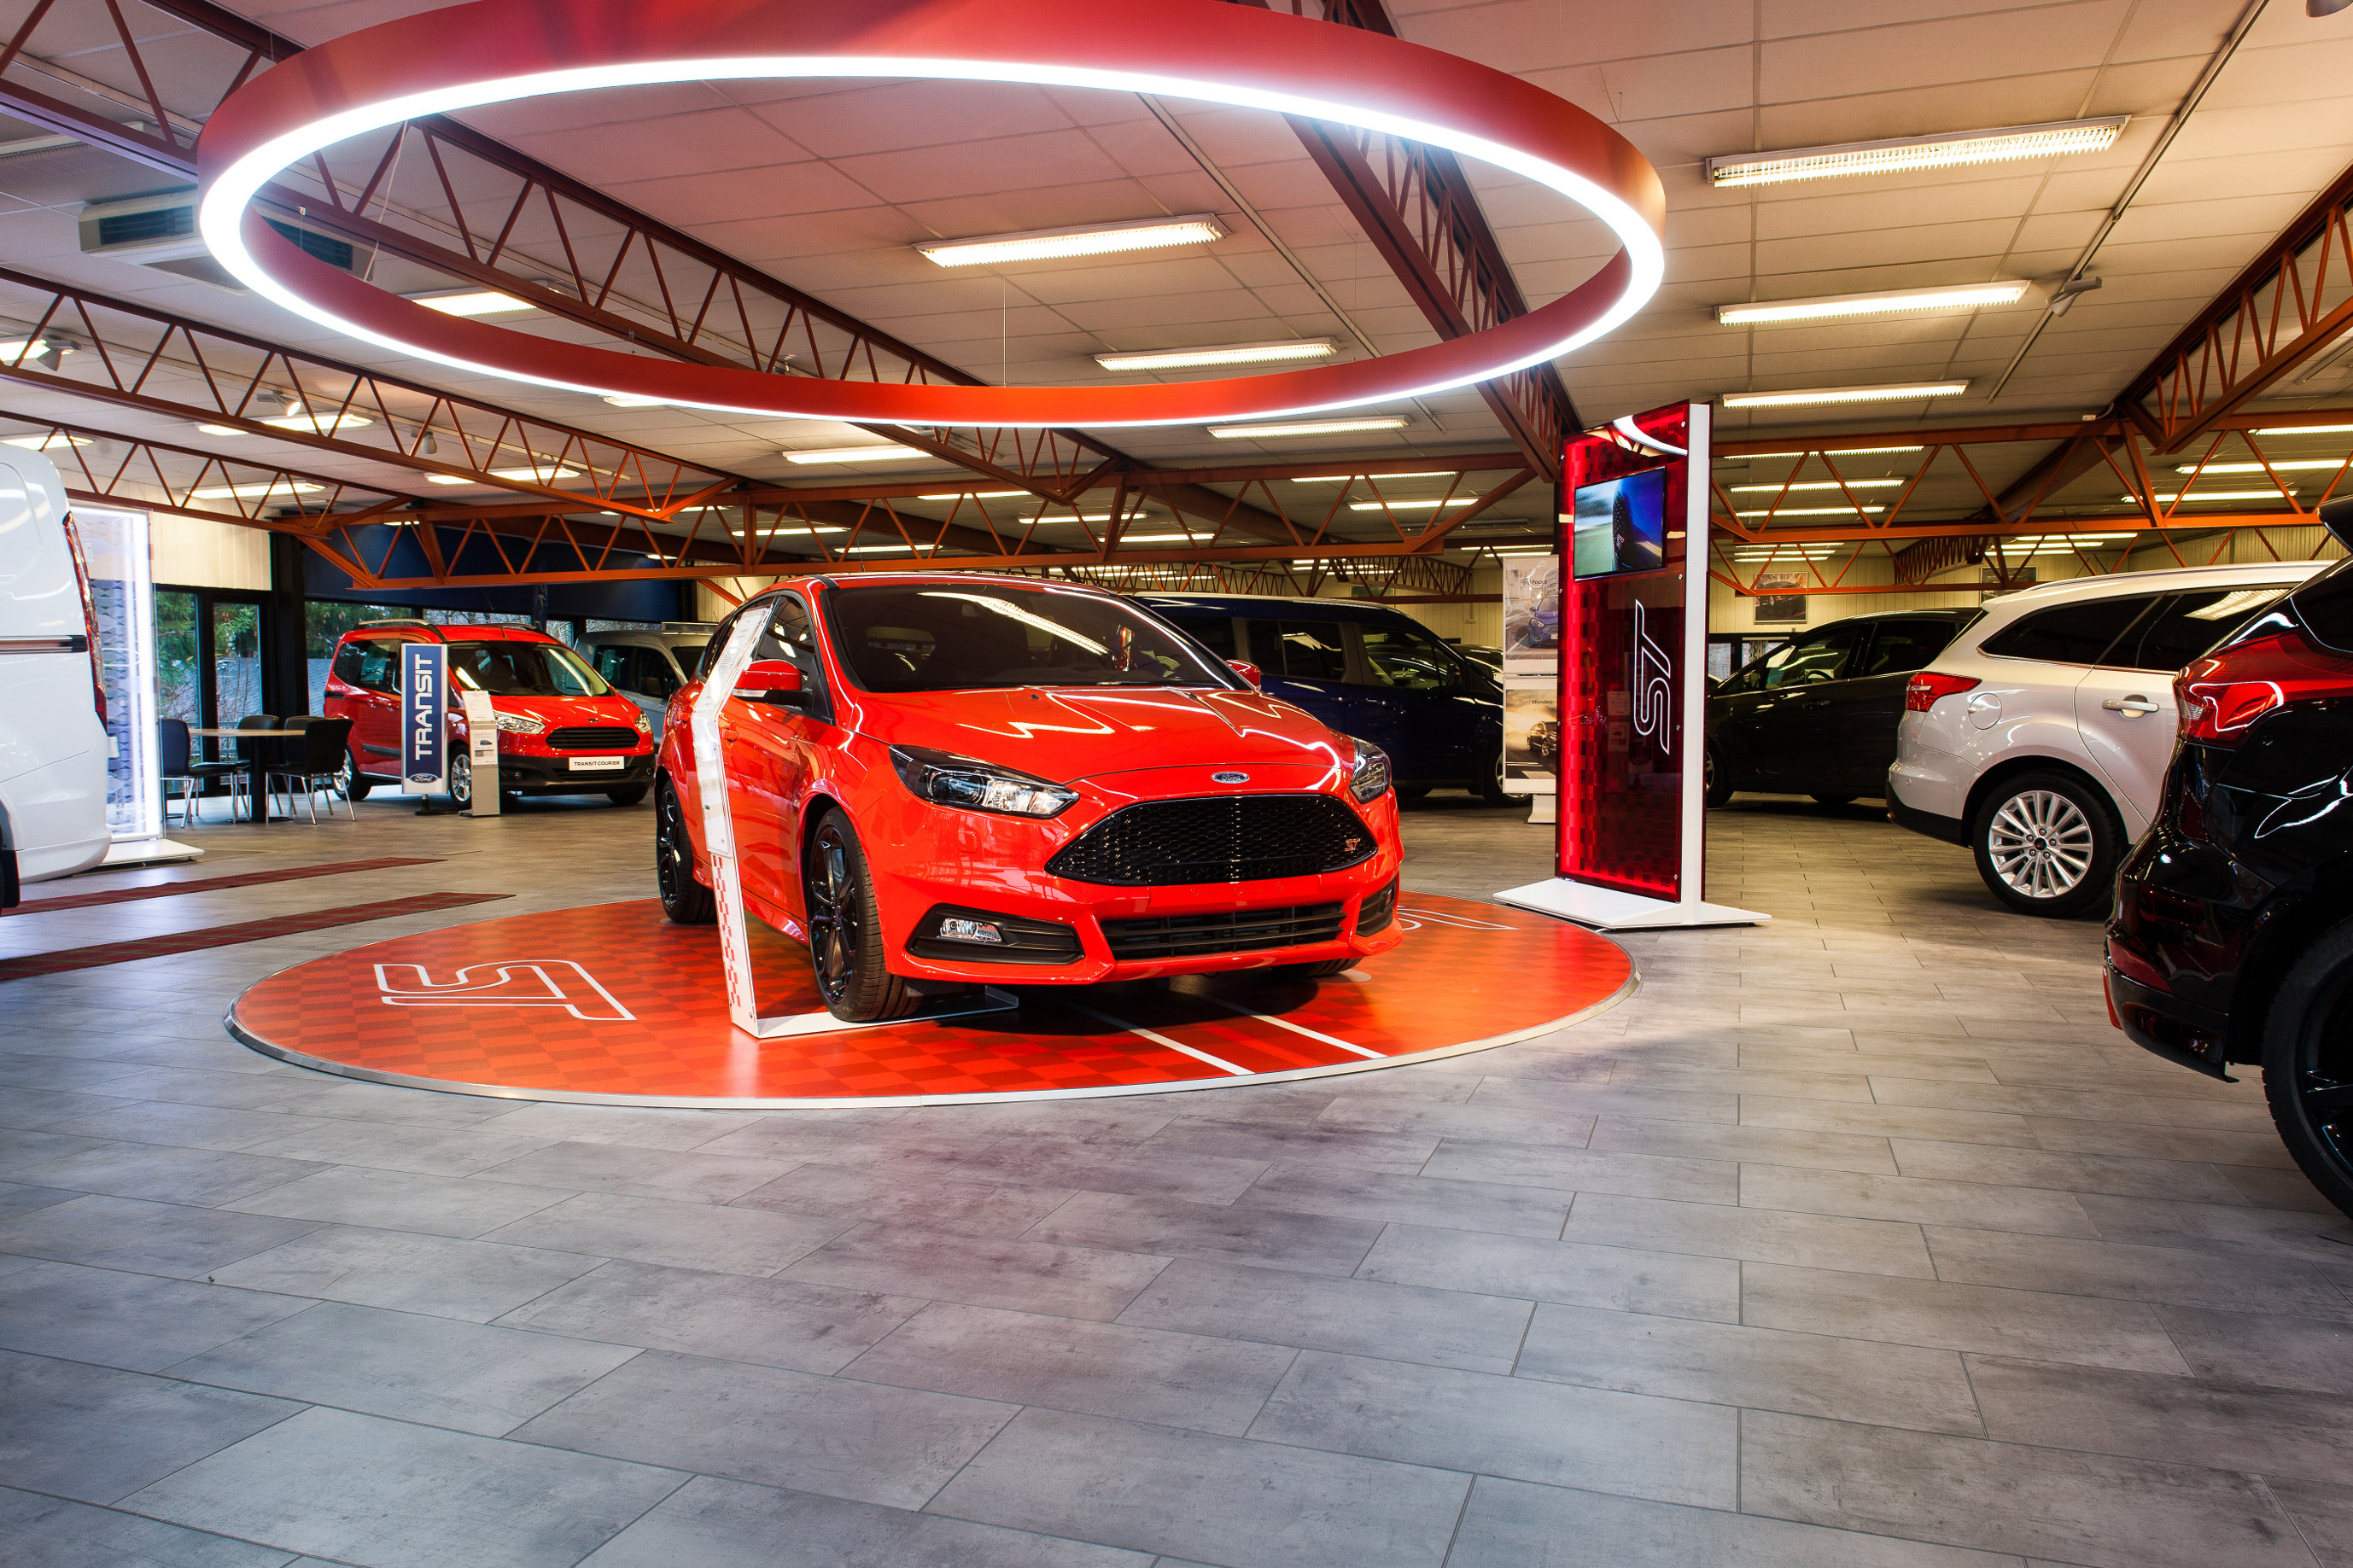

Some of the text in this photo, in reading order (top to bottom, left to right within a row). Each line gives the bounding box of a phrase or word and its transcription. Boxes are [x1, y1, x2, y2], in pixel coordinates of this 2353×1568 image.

[415, 653, 433, 761] TRANSIT
[1634, 598, 1671, 755] ST
[414, 773, 434, 783] Ford
[1345, 838, 1361, 852] ST
[373, 959, 638, 1021] ST
